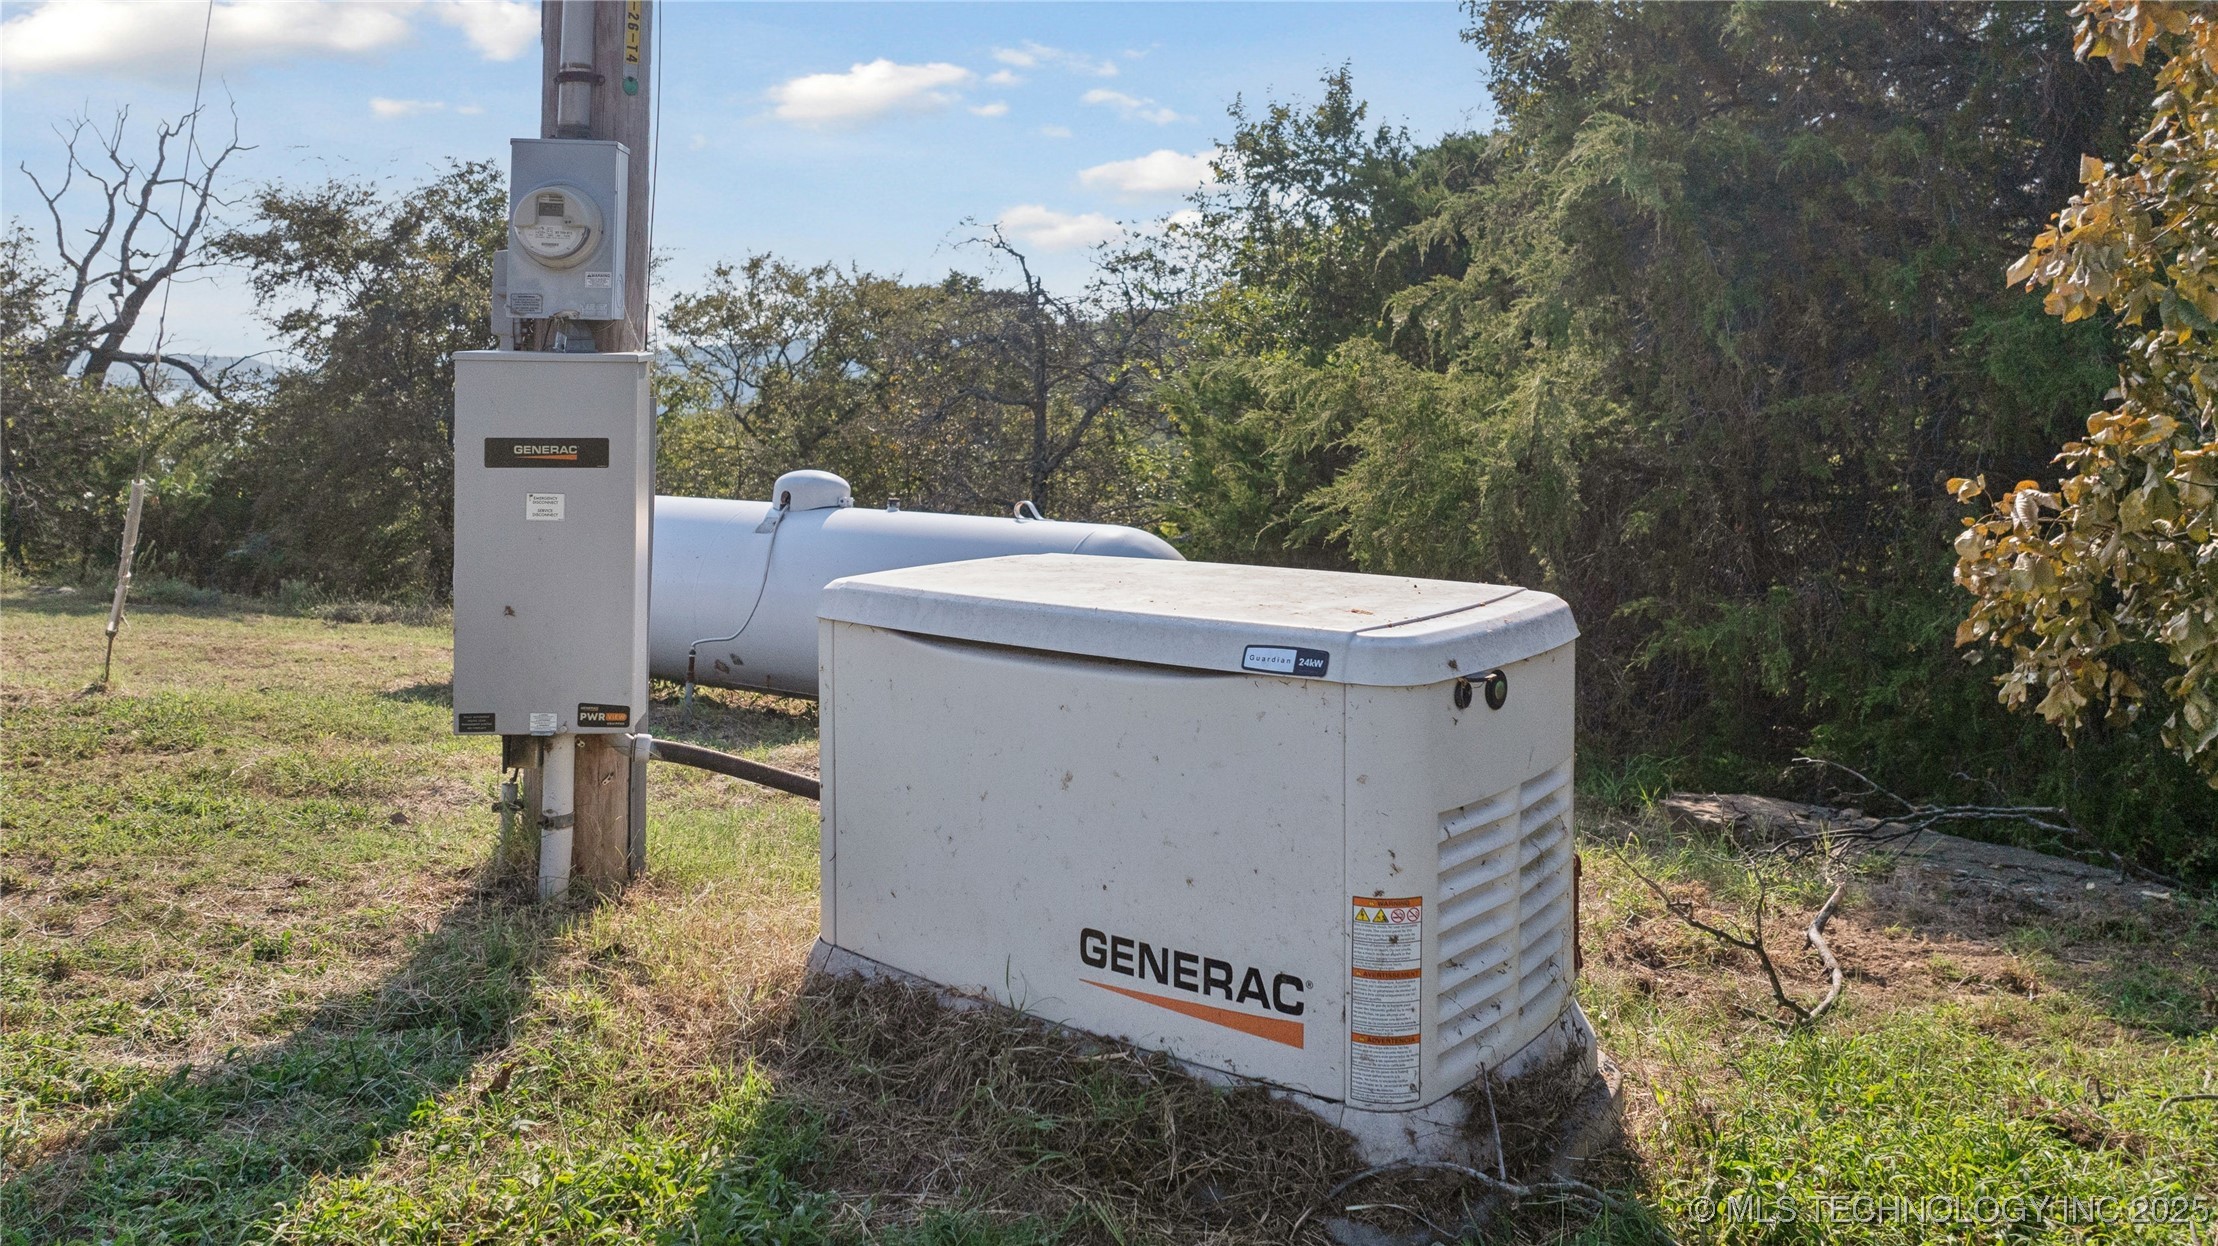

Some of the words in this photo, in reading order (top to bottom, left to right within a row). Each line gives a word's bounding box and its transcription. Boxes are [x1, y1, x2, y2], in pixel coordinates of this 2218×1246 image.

[513, 445, 578, 455] GENERAC
[1249, 654, 1291, 664] Guardian
[1298, 657, 1324, 669] 24kW
[1377, 899, 1410, 908] WARNING
[1363, 971, 1418, 979] AVERTISSEMENT
